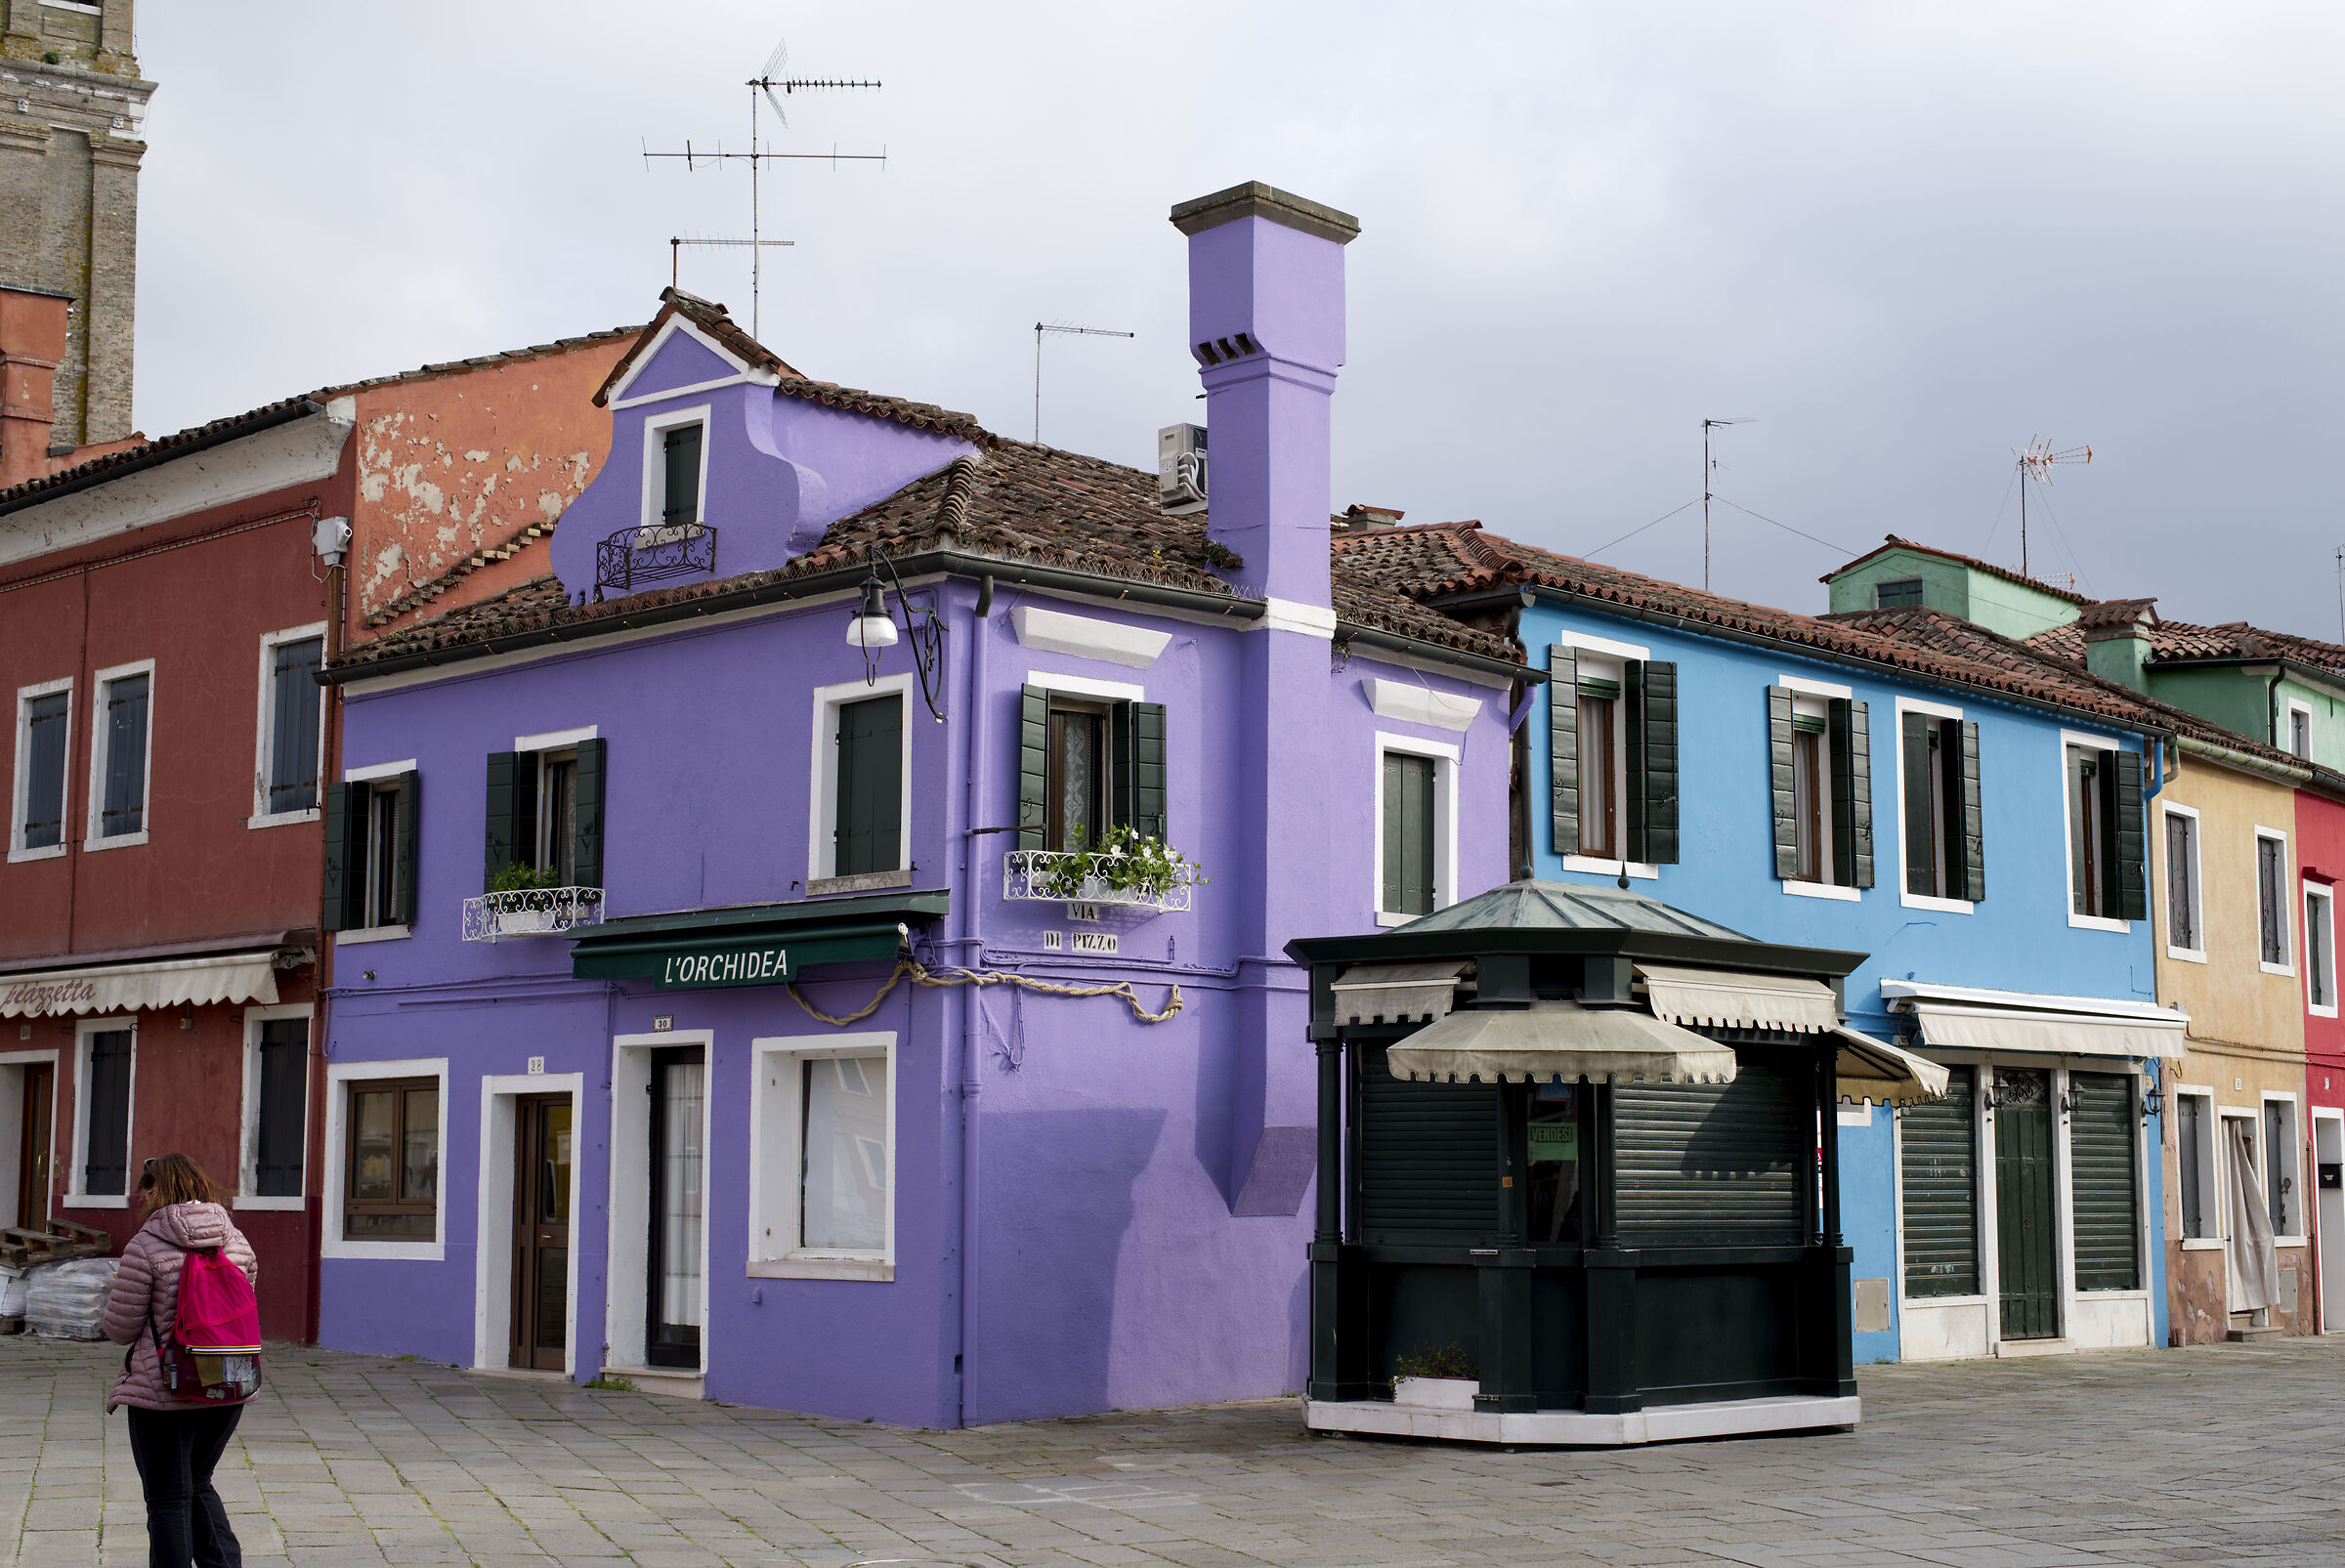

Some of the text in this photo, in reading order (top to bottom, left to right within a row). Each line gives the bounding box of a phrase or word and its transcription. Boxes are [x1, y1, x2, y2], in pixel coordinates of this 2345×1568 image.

[1072, 903, 1095, 919] VIA
[1045, 932, 1116, 951] DI PIZZO
[665, 950, 788, 983] L'ORCHIDEA
[658, 1019, 667, 1028] 30
[531, 1059, 542, 1072] 28
